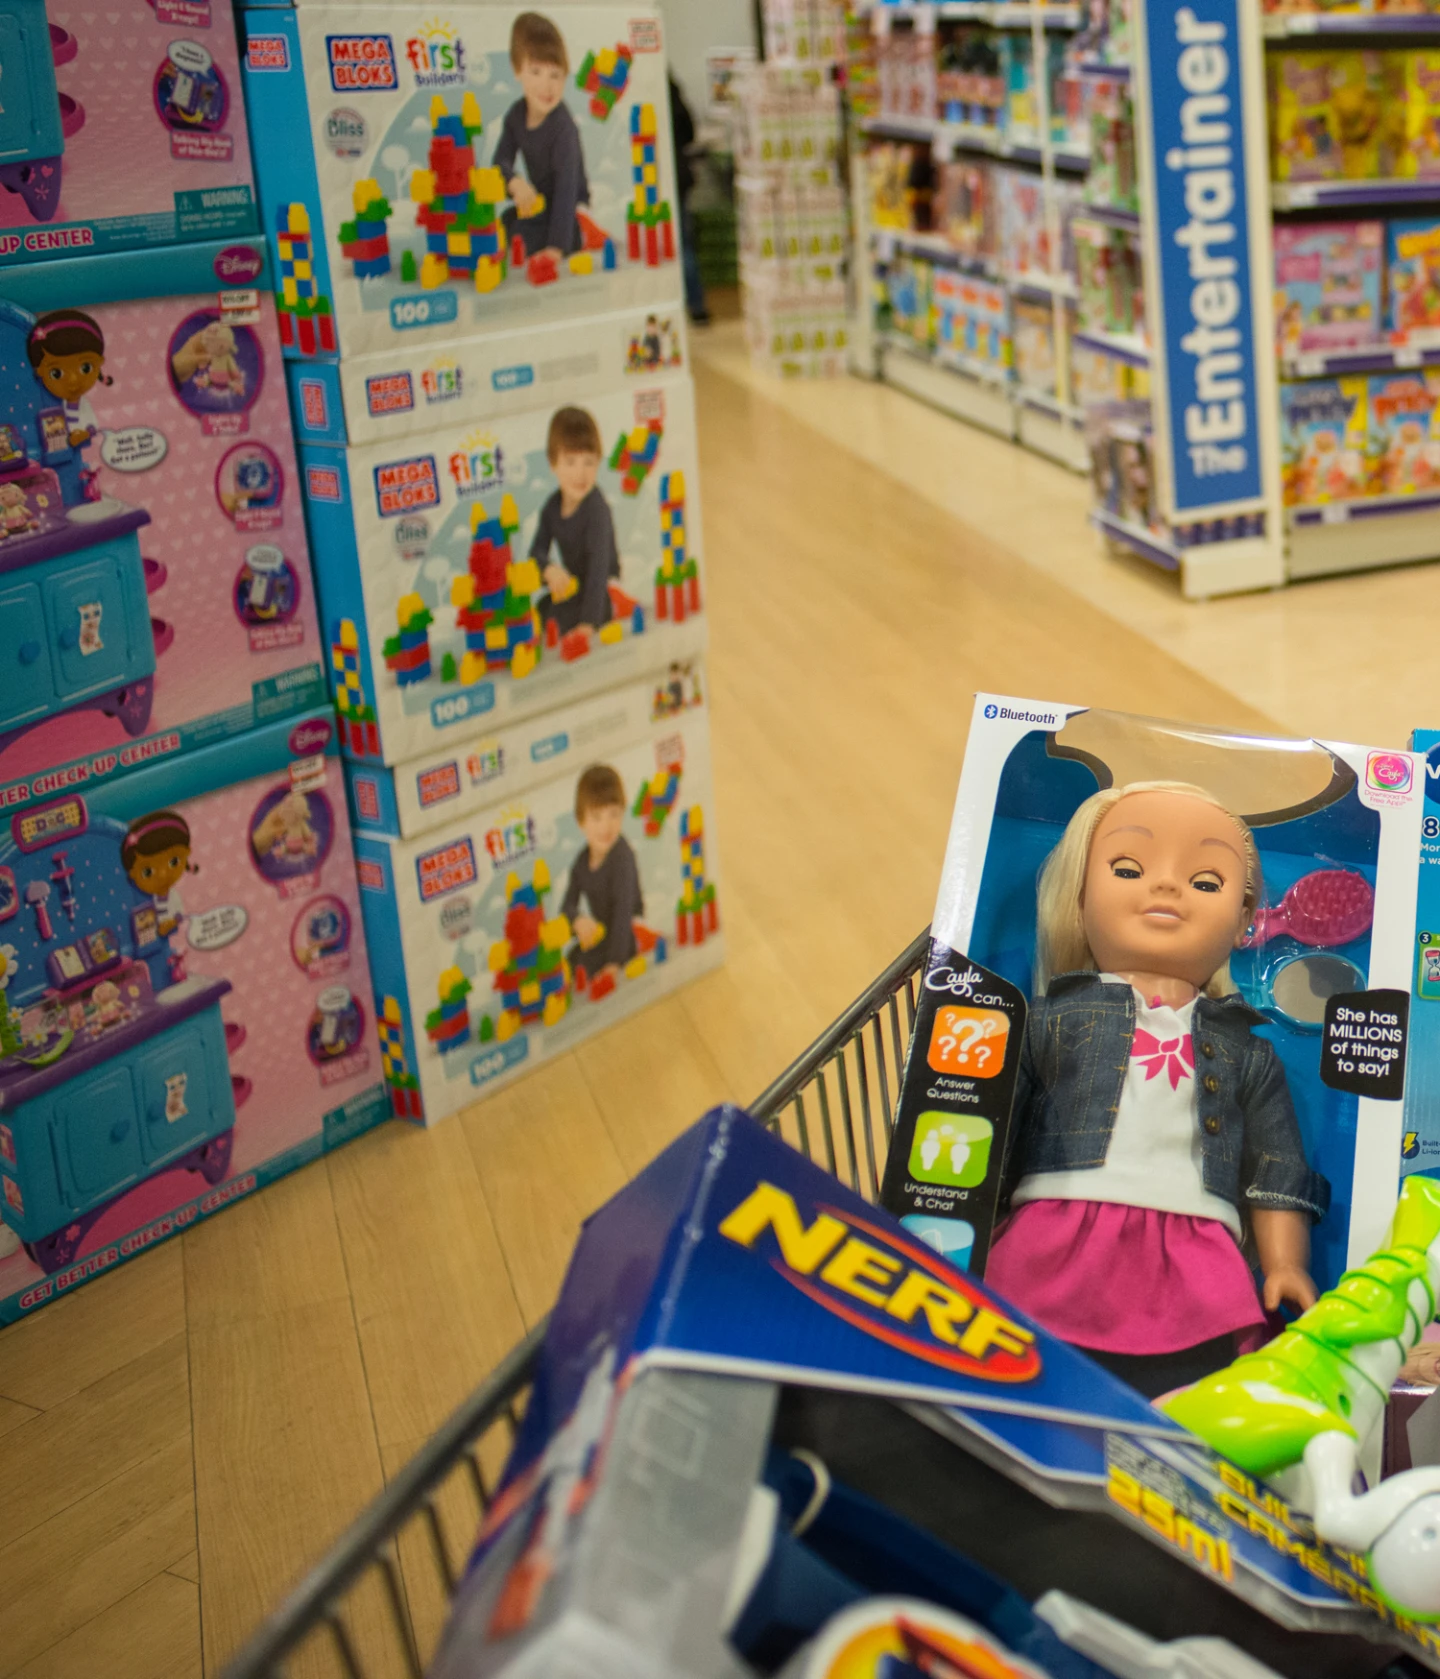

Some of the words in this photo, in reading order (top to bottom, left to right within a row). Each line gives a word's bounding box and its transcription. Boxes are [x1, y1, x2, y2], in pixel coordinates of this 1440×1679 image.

[248, 38, 283, 53] MEGA
[331, 38, 388, 62] MEGA
[405, 36, 466, 73] first
[250, 53, 286, 67] BLOKS
[334, 64, 393, 89] BLOKS
[328, 119, 364, 138] Bliss
[1164, 6, 1247, 444] Entertainer
[25, 227, 94, 252] CENTER
[393, 300, 429, 324] 100
[370, 376, 410, 394] MEGA
[421, 365, 463, 395] first
[379, 460, 432, 485] MEGA
[448, 444, 504, 483] first
[381, 486, 437, 514] BLOKS
[434, 694, 470, 721] 100
[1000, 707, 1055, 725] Bluetooth
[33, 752, 117, 796] CHECK-UP
[121, 733, 182, 767] CENTER
[1364, 789, 1400, 800] Download
[1370, 796, 1385, 804] Free
[484, 815, 536, 860] first
[421, 841, 470, 874] MEGA
[1422, 933, 1430, 943] 3
[924, 964, 984, 998] Cayla
[972, 992, 1015, 1008] can...
[1336, 1007, 1366, 1023] She
[1369, 1010, 1399, 1026] has
[1329, 1023, 1403, 1043] MILLIONS
[1330, 1041, 1349, 1055] of
[1351, 1042, 1400, 1062] things
[1336, 1058, 1355, 1073] to
[1358, 1062, 1390, 1079] say!
[926, 1087, 980, 1104] Questions
[935, 1076, 976, 1091] Answer
[904, 1182, 969, 1201] Understand
[913, 1196, 924, 1208] &
[925, 1198, 955, 1212] Chat
[20, 1283, 54, 1309] GET
[57, 1246, 118, 1292] BETTER
[121, 1205, 198, 1257] CHECK-UP
[202, 1176, 257, 1214] CENTER
[718, 1180, 1036, 1362] NERF
